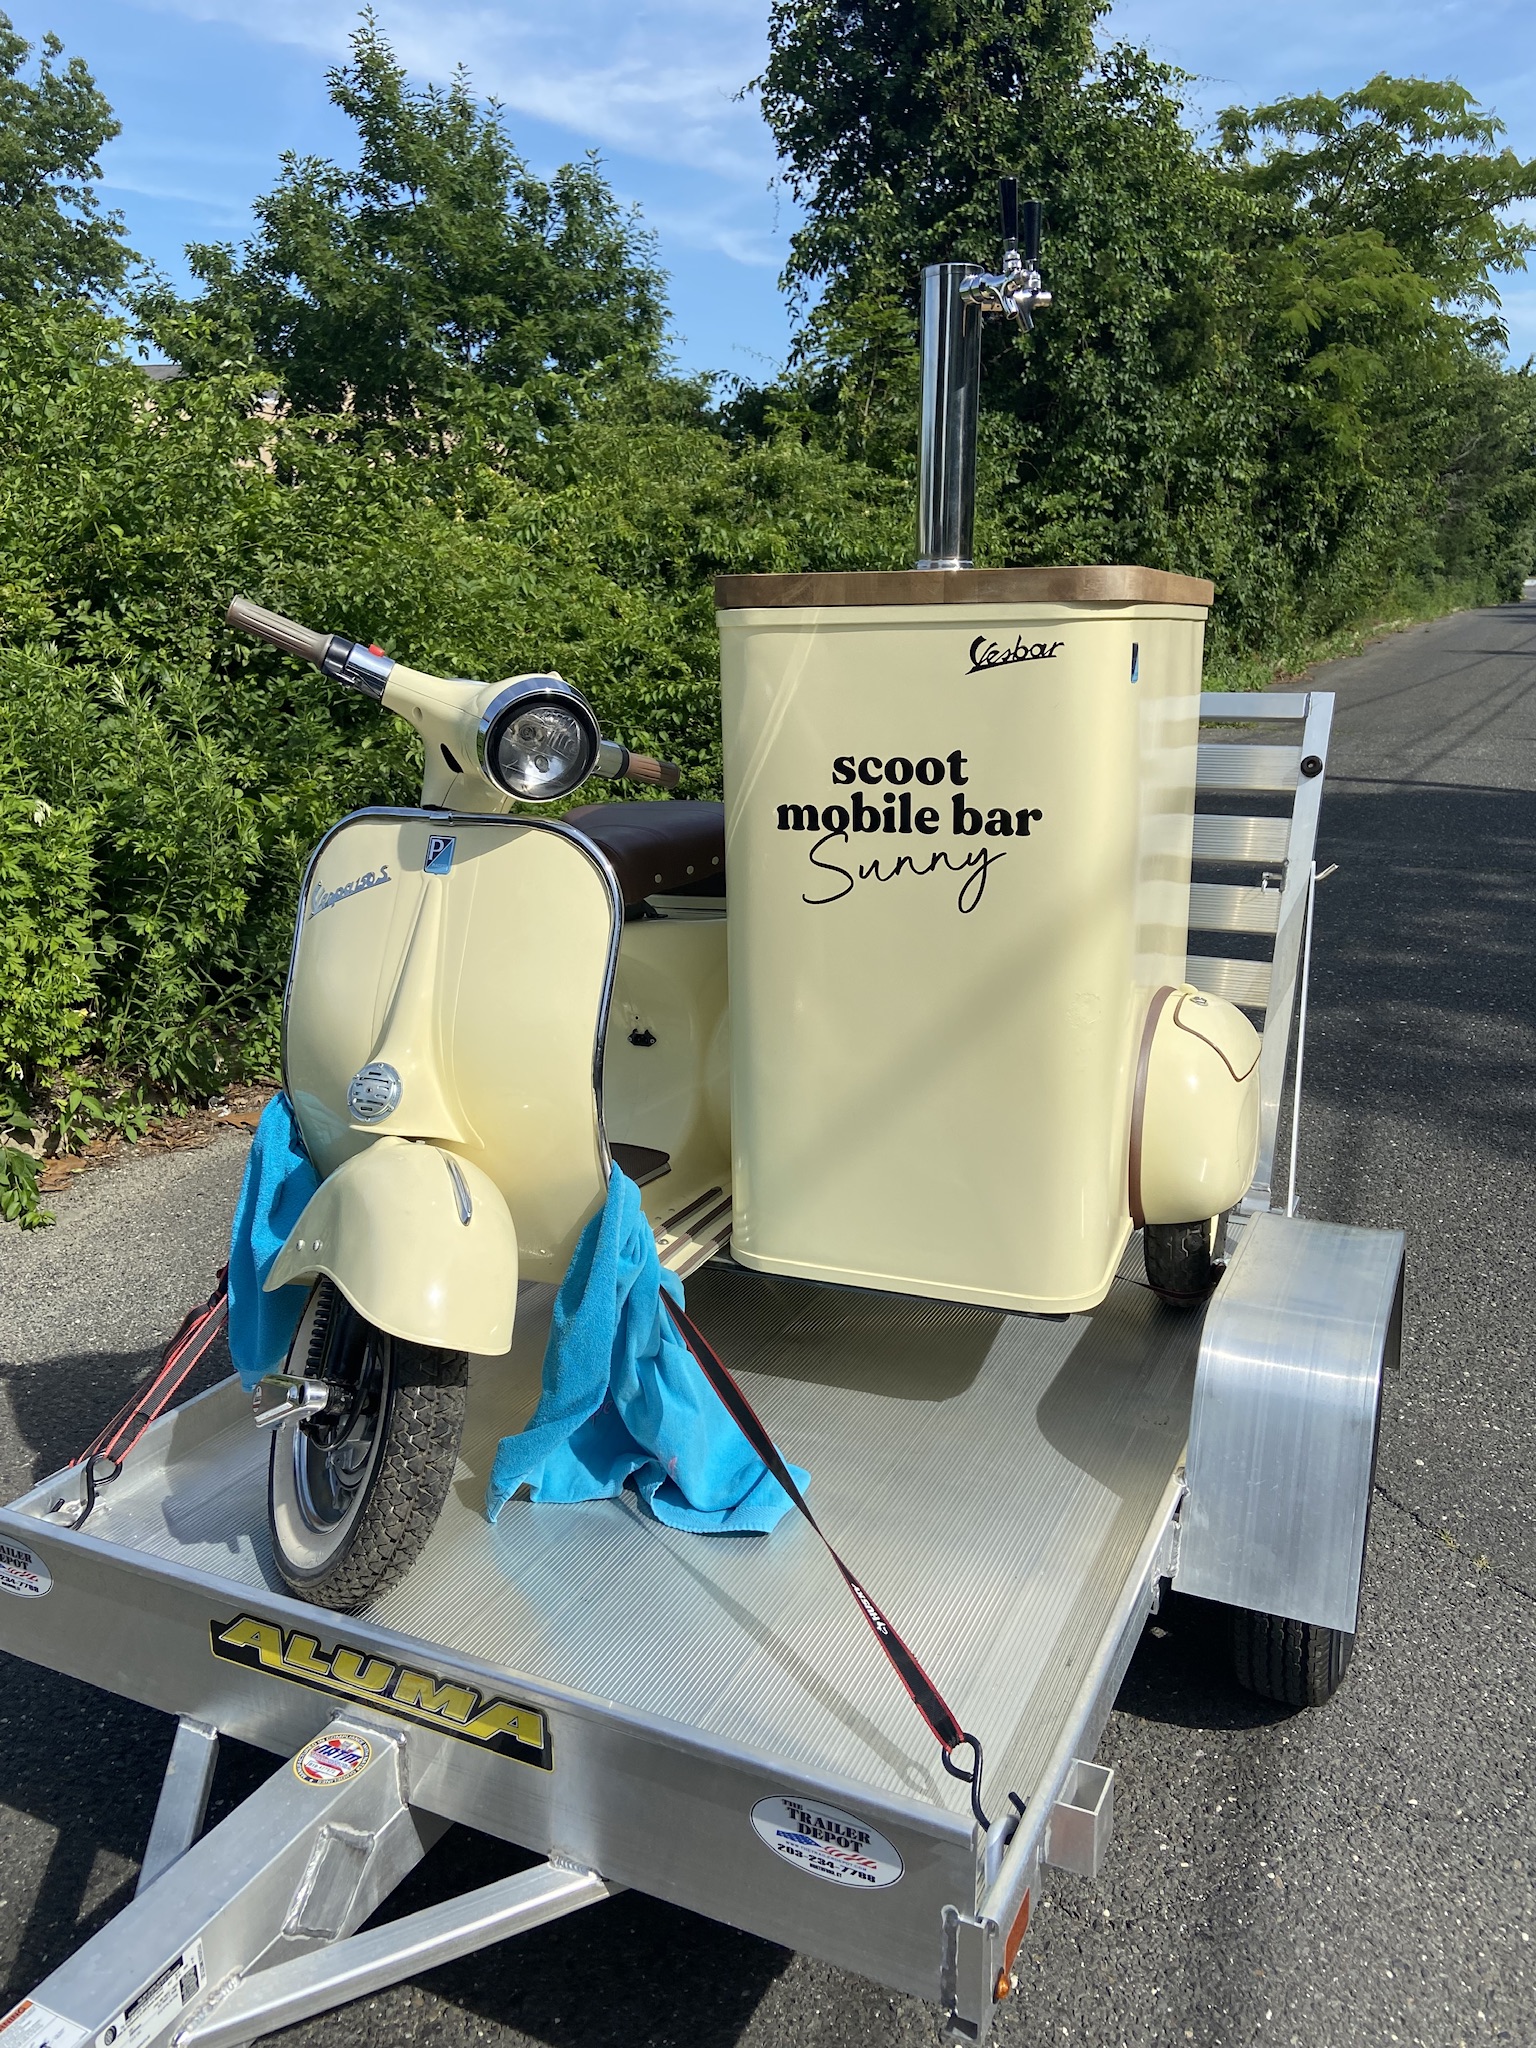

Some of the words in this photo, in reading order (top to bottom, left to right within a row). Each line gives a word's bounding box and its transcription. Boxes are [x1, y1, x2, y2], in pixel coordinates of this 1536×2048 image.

[964, 634, 1065, 675] Vesbar
[831, 749, 969, 787] scoot
[776, 791, 940, 836] mobile
[951, 792, 1044, 837] bar
[801, 831, 1008, 914] Sunny
[0, 1544, 32, 1564] AILER
[0, 1553, 29, 1571] EPOT
[218, 1616, 545, 1750] ALUMA
[781, 1798, 804, 1811] THE
[786, 1806, 871, 1845] TRAILER
[797, 1822, 863, 1853] DEPOT
[777, 1843, 876, 1883] 203-234-7788
